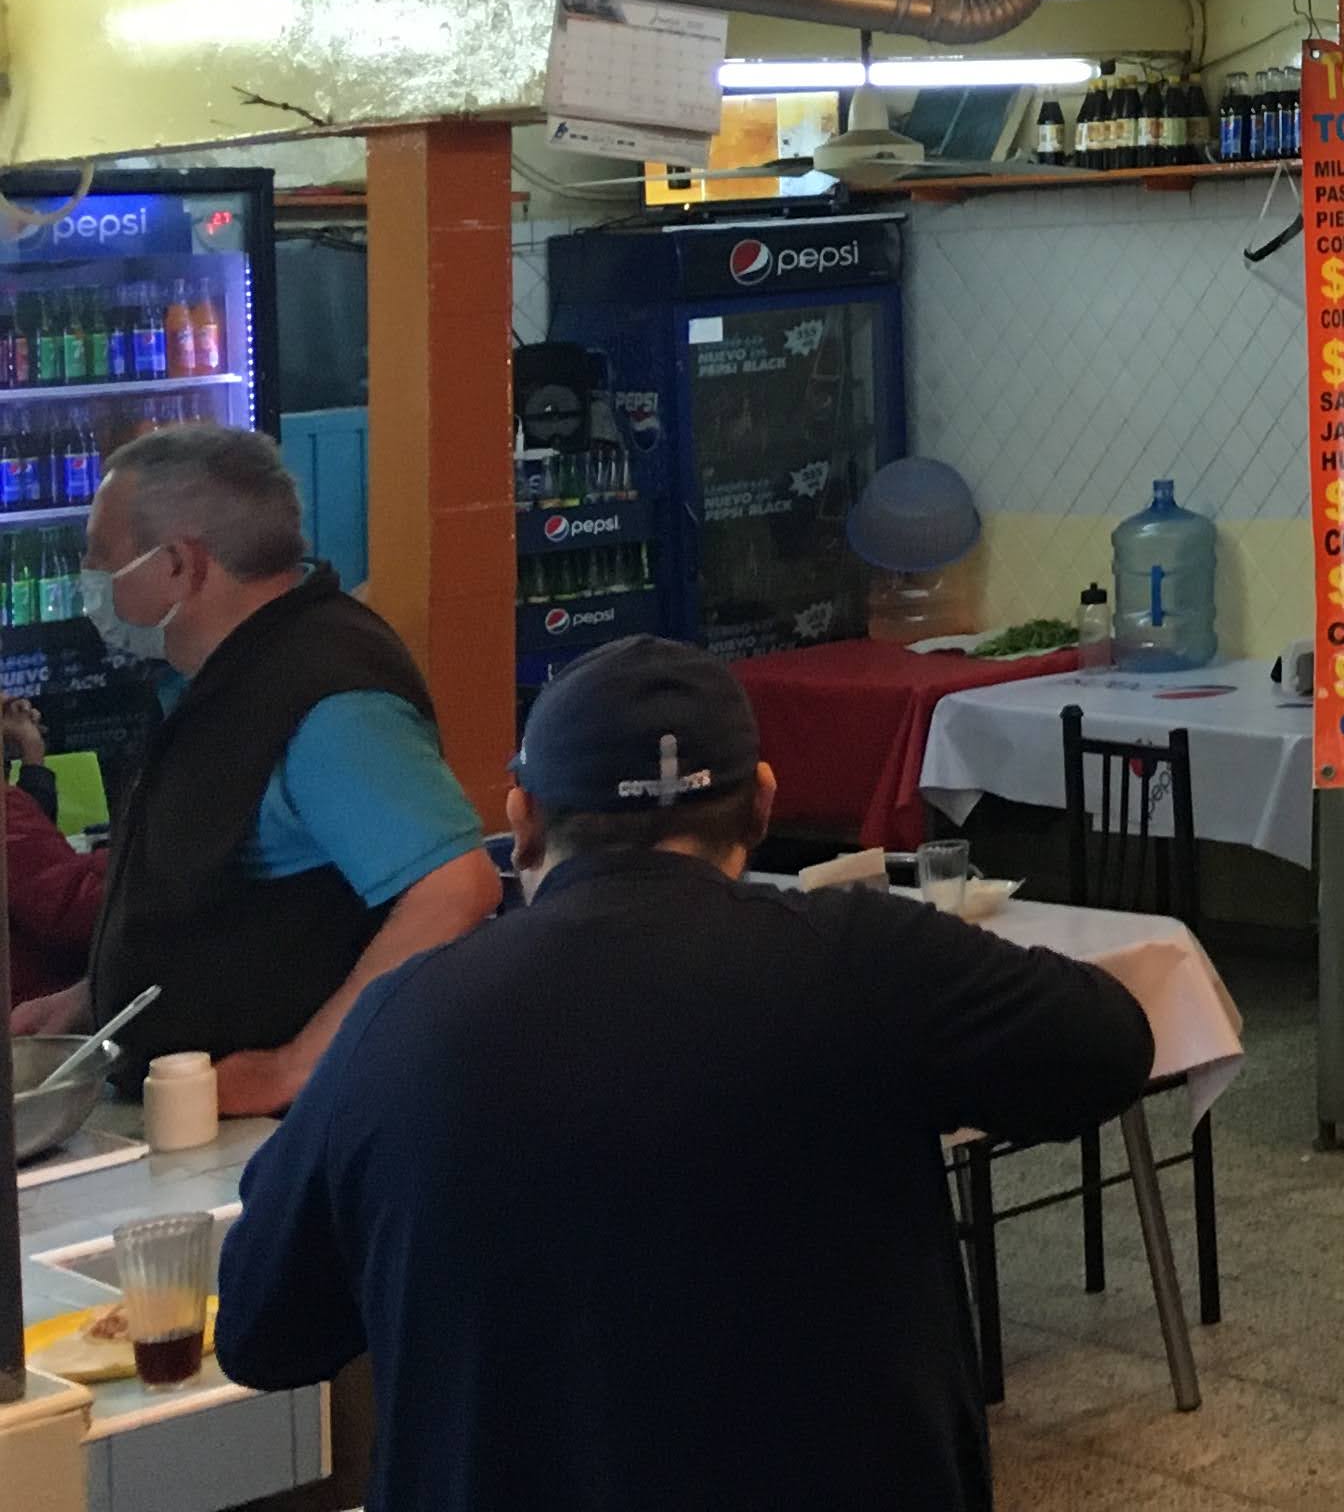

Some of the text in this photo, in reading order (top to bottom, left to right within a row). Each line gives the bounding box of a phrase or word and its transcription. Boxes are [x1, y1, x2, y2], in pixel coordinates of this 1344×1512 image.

[53, 207, 147, 245] pepsi
[776, 240, 859, 275] pepsi
[615, 392, 658, 411] PEPSI
[571, 515, 621, 536] pepsi
[572, 608, 615, 627] pepsi
